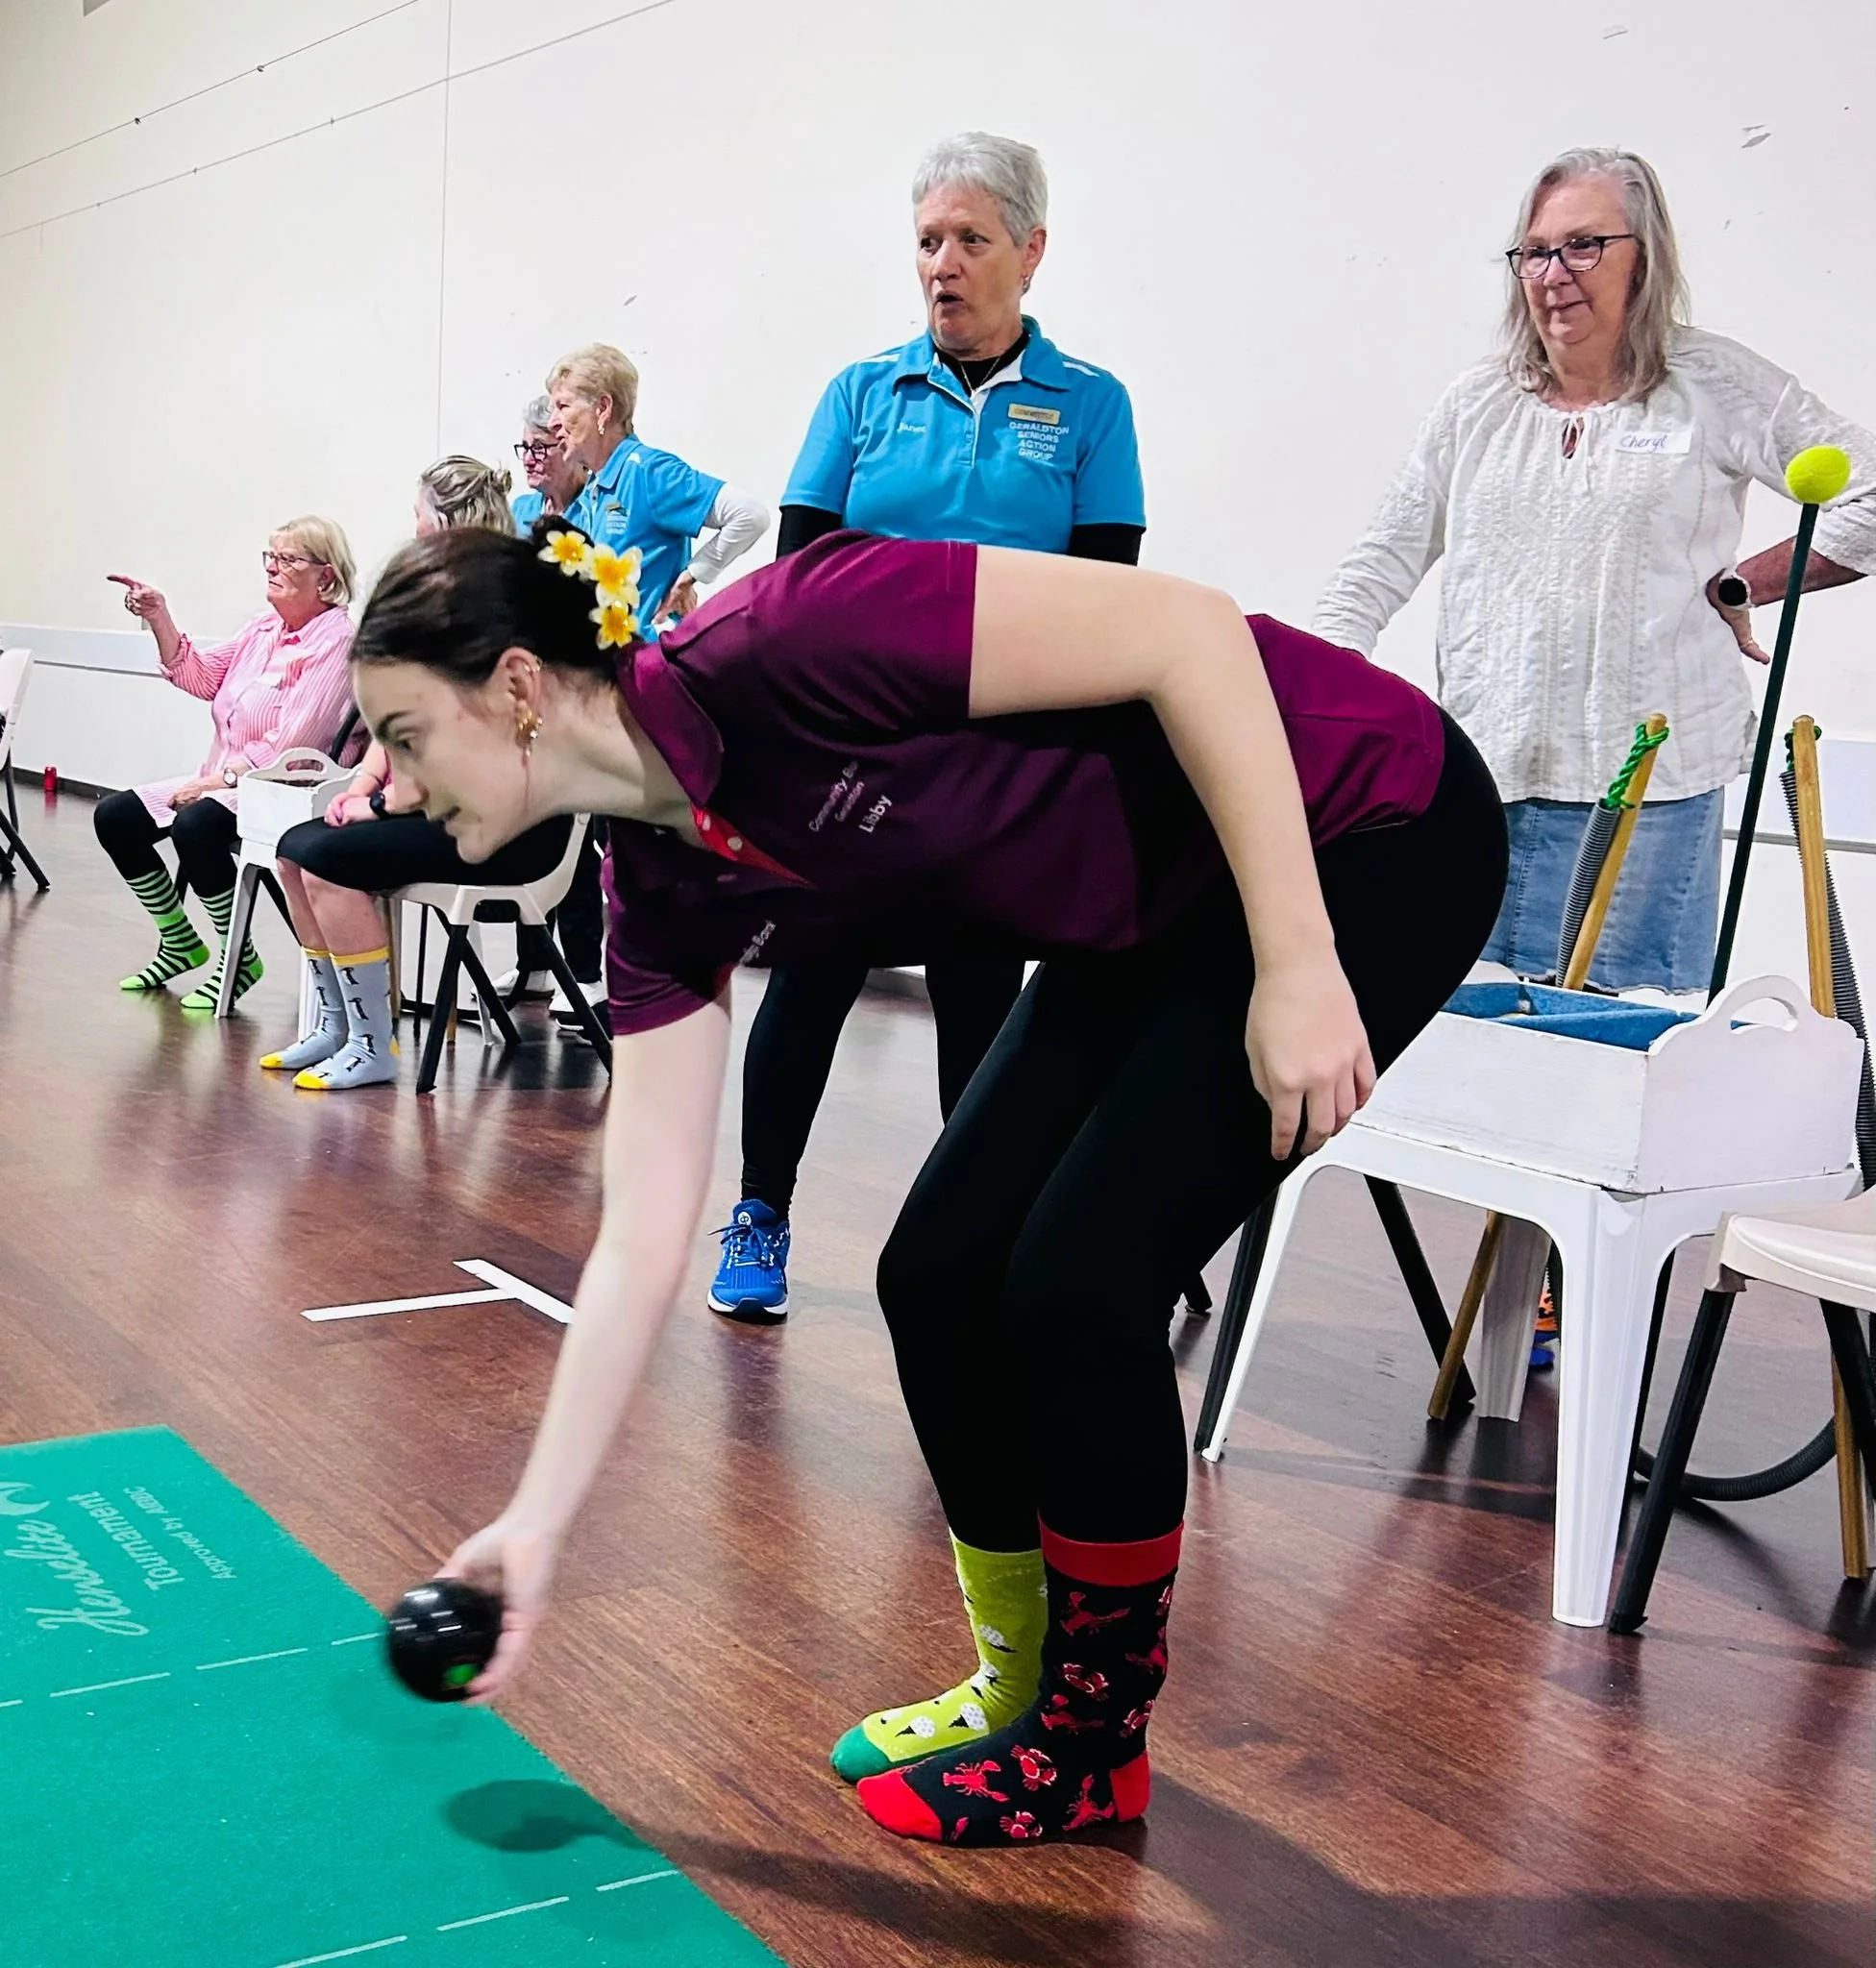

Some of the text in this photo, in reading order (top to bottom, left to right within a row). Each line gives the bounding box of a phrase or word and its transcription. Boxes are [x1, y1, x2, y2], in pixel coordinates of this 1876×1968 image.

[1009, 422, 1070, 435] GERALDTON
[1017, 430, 1060, 443] SENIORS
[1619, 434, 1667, 452] Cheryl
[1019, 439, 1056, 453] ACTION
[1018, 448, 1054, 461] GROUP
[859, 794, 892, 833] Libby
[160, 1517, 185, 1531] by
[66, 1490, 185, 1591] Tournament
[169, 1531, 236, 1579] Approved
